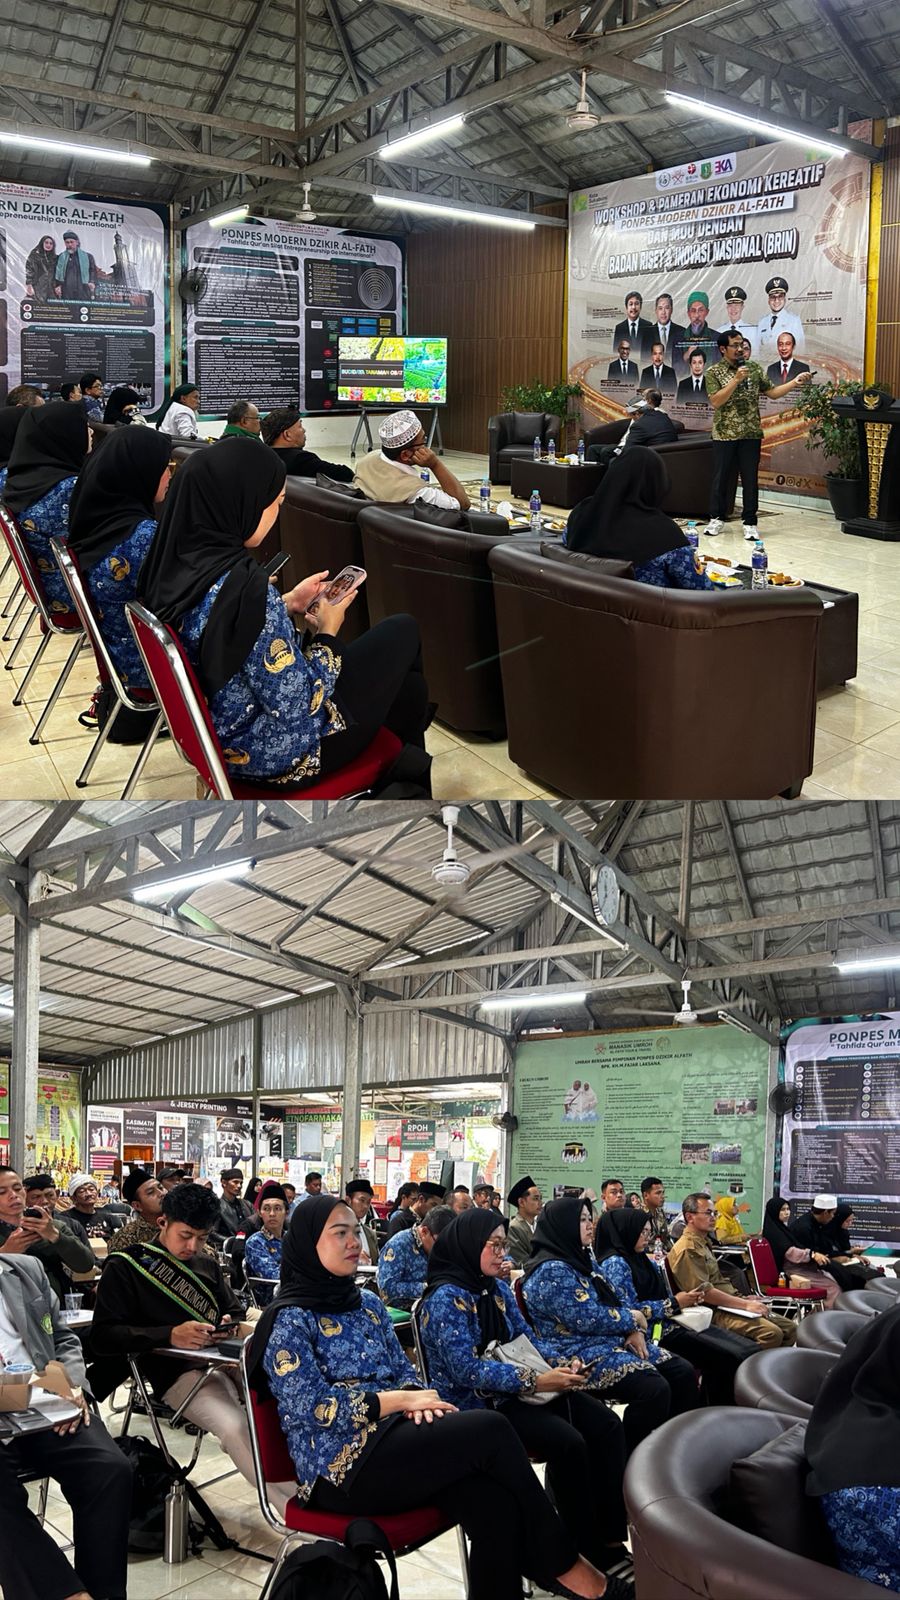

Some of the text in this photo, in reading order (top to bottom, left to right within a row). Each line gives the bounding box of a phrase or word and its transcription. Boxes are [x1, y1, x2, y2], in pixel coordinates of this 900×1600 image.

[594, 164, 825, 226] WORKSHOP & PAMERAN EKONOMI KEREATIF
[23, 202, 68, 218] DZIKIR
[72, 208, 124, 224] AL-FATH
[68, 218, 116, 229] International
[620, 196, 785, 229] PONPES MODERN DZIKIR AL-FATH
[698, 214, 743, 238] DENGAN
[222, 228, 262, 241] PONPES
[264, 232, 307, 247] MODERN
[310, 238, 340, 250] DZIKIR
[342, 242, 376, 254] AL-FATH
[609, 252, 639, 275] BADAN
[712, 234, 762, 261] NASIONAL
[764, 227, 797, 259] (BRIN)
[830, 1029, 884, 1043] PONPES
[867, 1040, 896, 1049] Qur'an
[176, 1101, 199, 1110] JERSEY
[200, 1103, 227, 1112] PRINTING
[285, 1114, 342, 1122] ETNOFARMAKA
[407, 1124, 428, 1132] RPOH
[154, 1262, 175, 1284] DUTA
